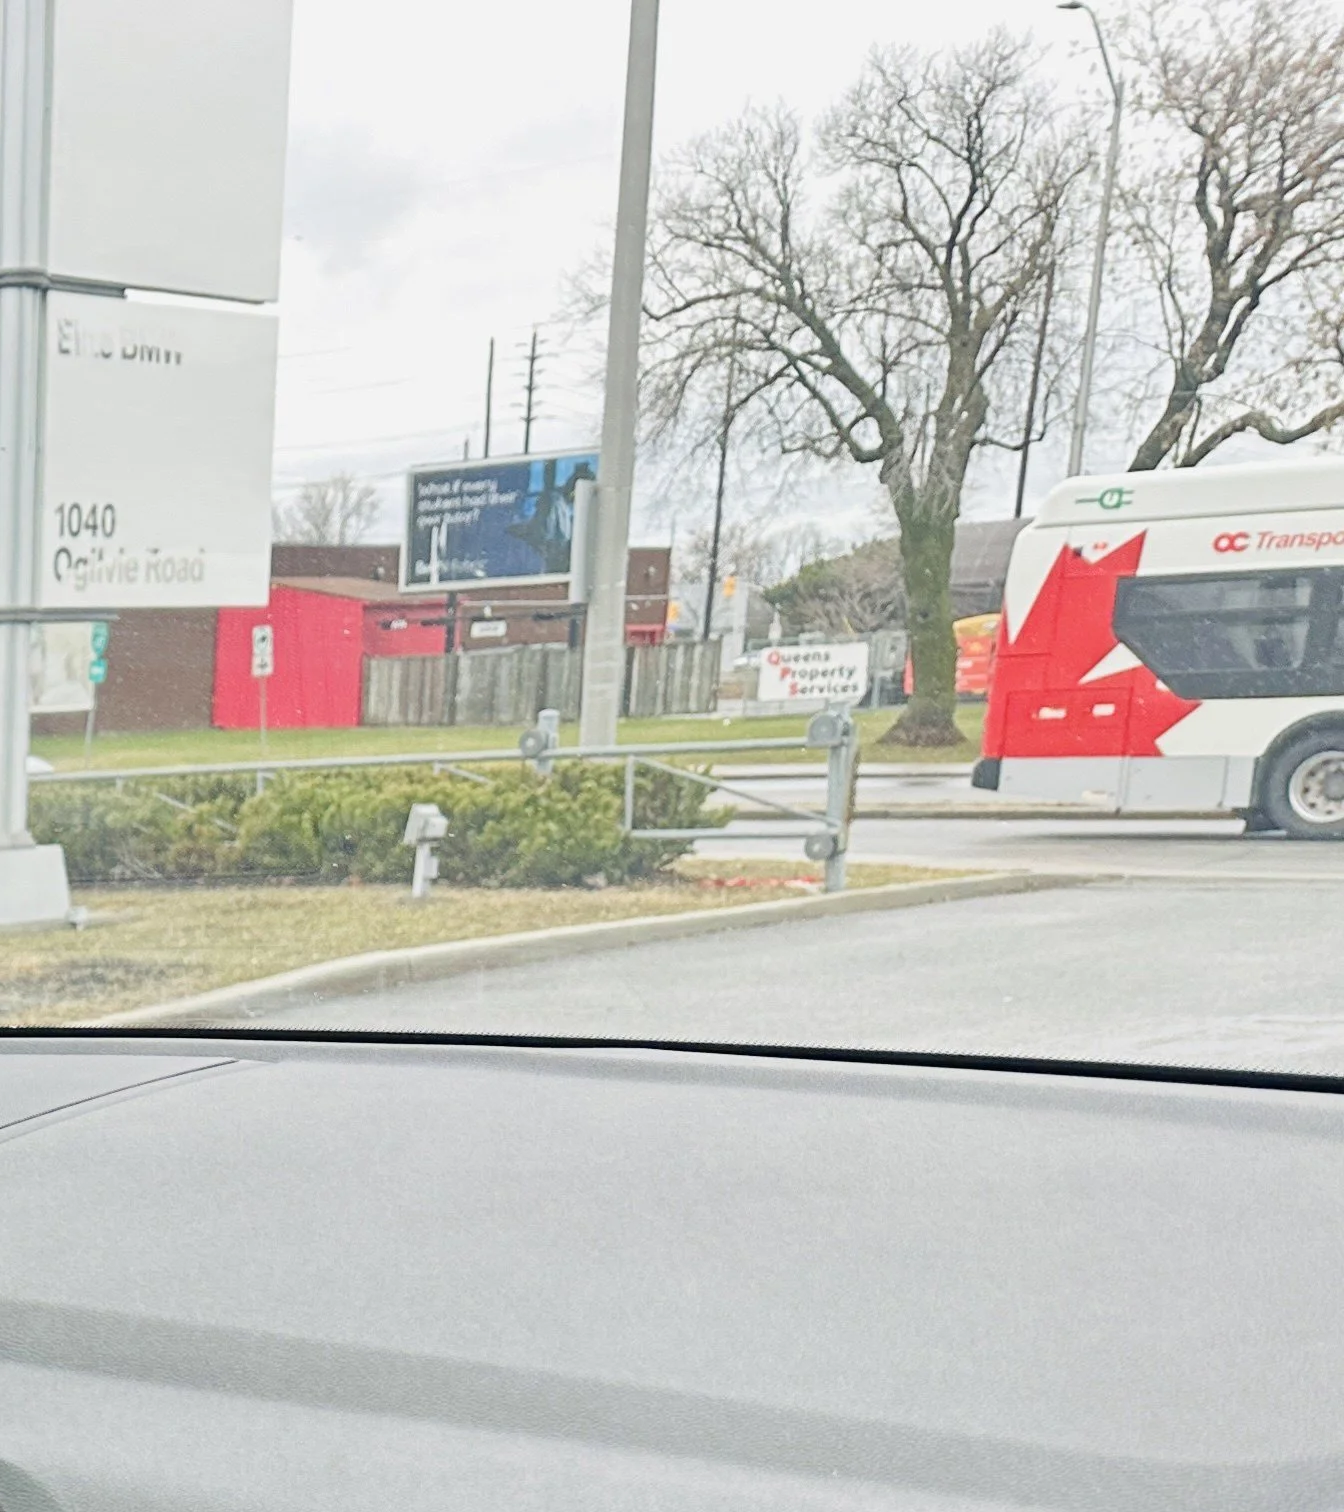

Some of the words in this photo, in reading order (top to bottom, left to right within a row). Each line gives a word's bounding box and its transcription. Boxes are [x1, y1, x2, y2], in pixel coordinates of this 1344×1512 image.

[54, 502, 116, 538] 1040
[1212, 531, 1251, 553] OC
[1256, 530, 1344, 552] Transpo
[768, 650, 830, 667] Queens
[780, 665, 857, 682] Property
[789, 682, 859, 696] Services
